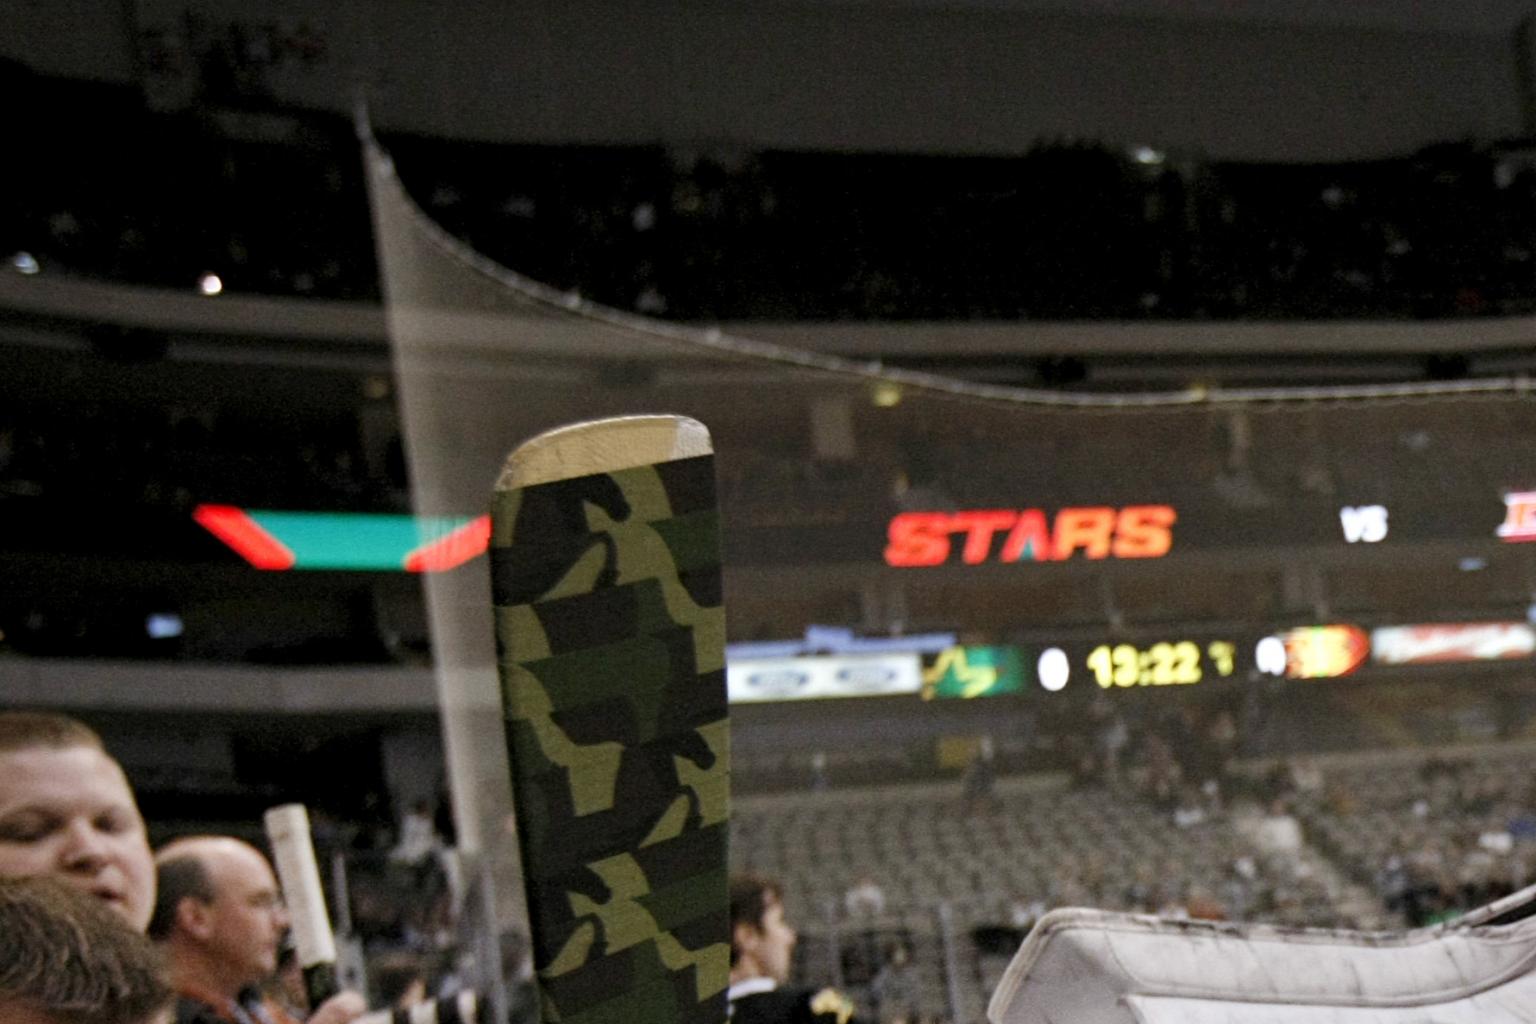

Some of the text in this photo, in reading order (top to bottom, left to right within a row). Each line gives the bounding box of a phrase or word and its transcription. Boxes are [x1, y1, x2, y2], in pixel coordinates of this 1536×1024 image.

[885, 505, 1178, 567] STARS
[1340, 505, 1389, 543] VS
[1038, 647, 1070, 691] 0
[1086, 641, 1203, 689] 13:22
